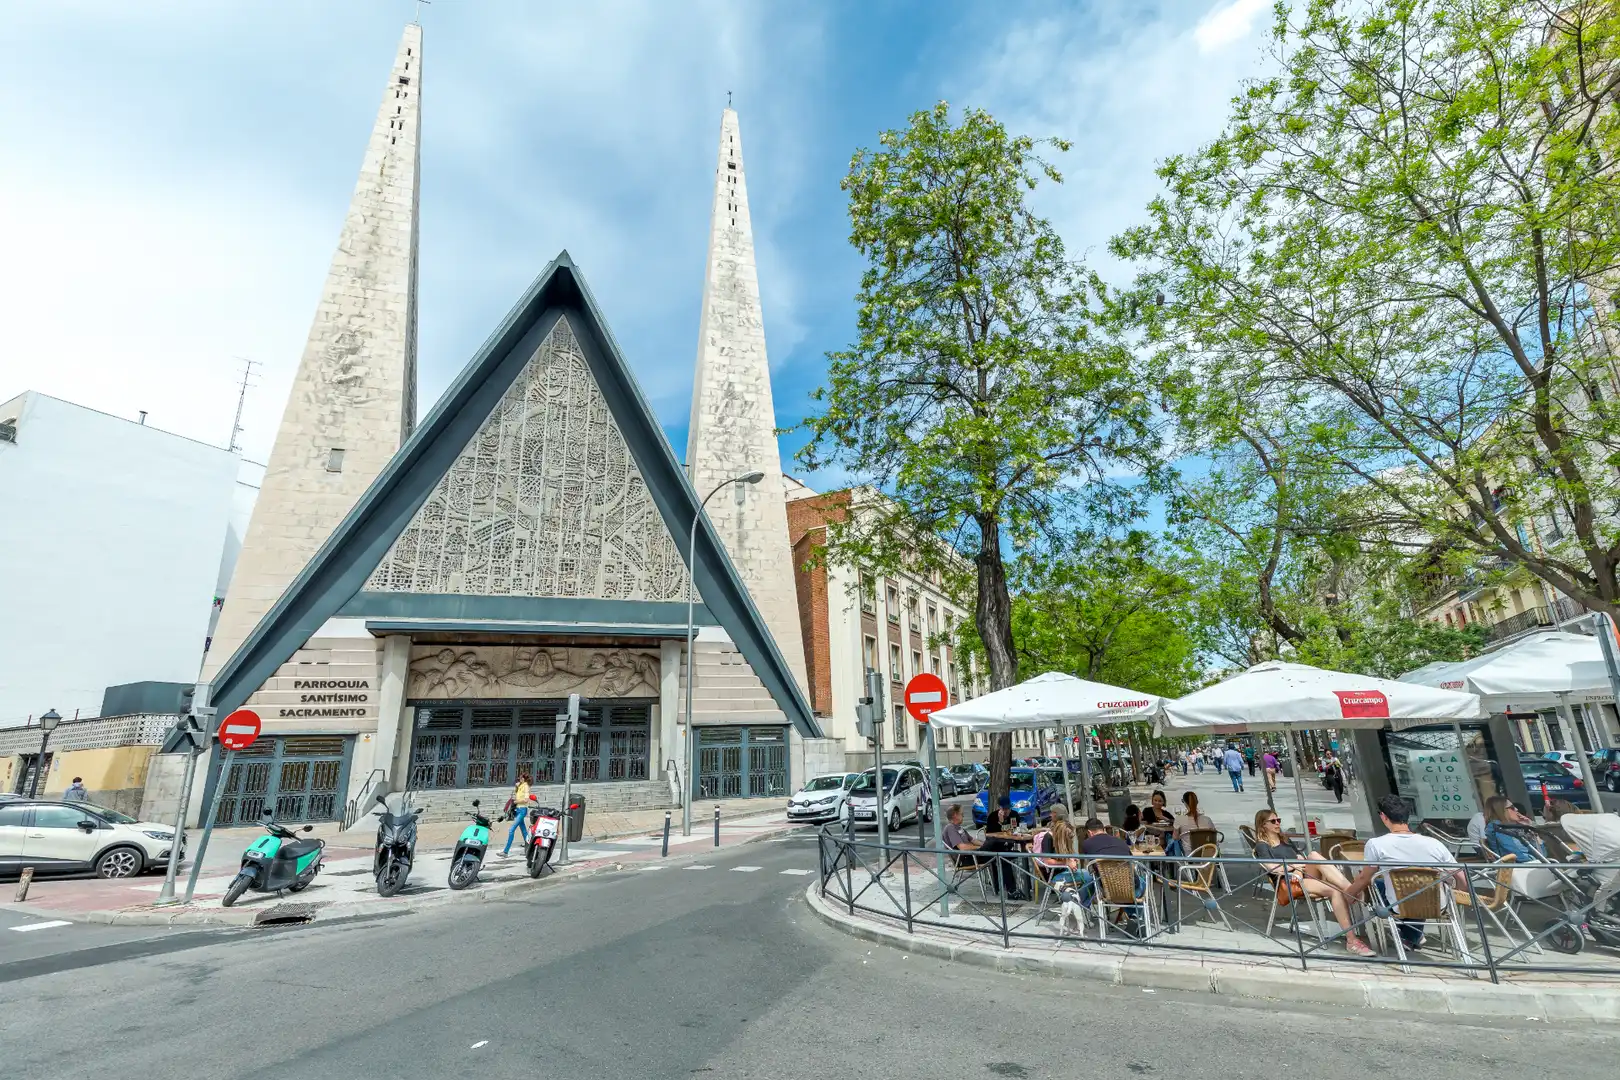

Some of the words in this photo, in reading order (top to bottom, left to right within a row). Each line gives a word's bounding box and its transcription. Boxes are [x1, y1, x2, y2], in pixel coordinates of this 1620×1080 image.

[294, 680, 369, 689] PARROQUIA
[301, 693, 368, 703] SANTÍSIMO
[279, 708, 366, 717] SACRAMENTO
